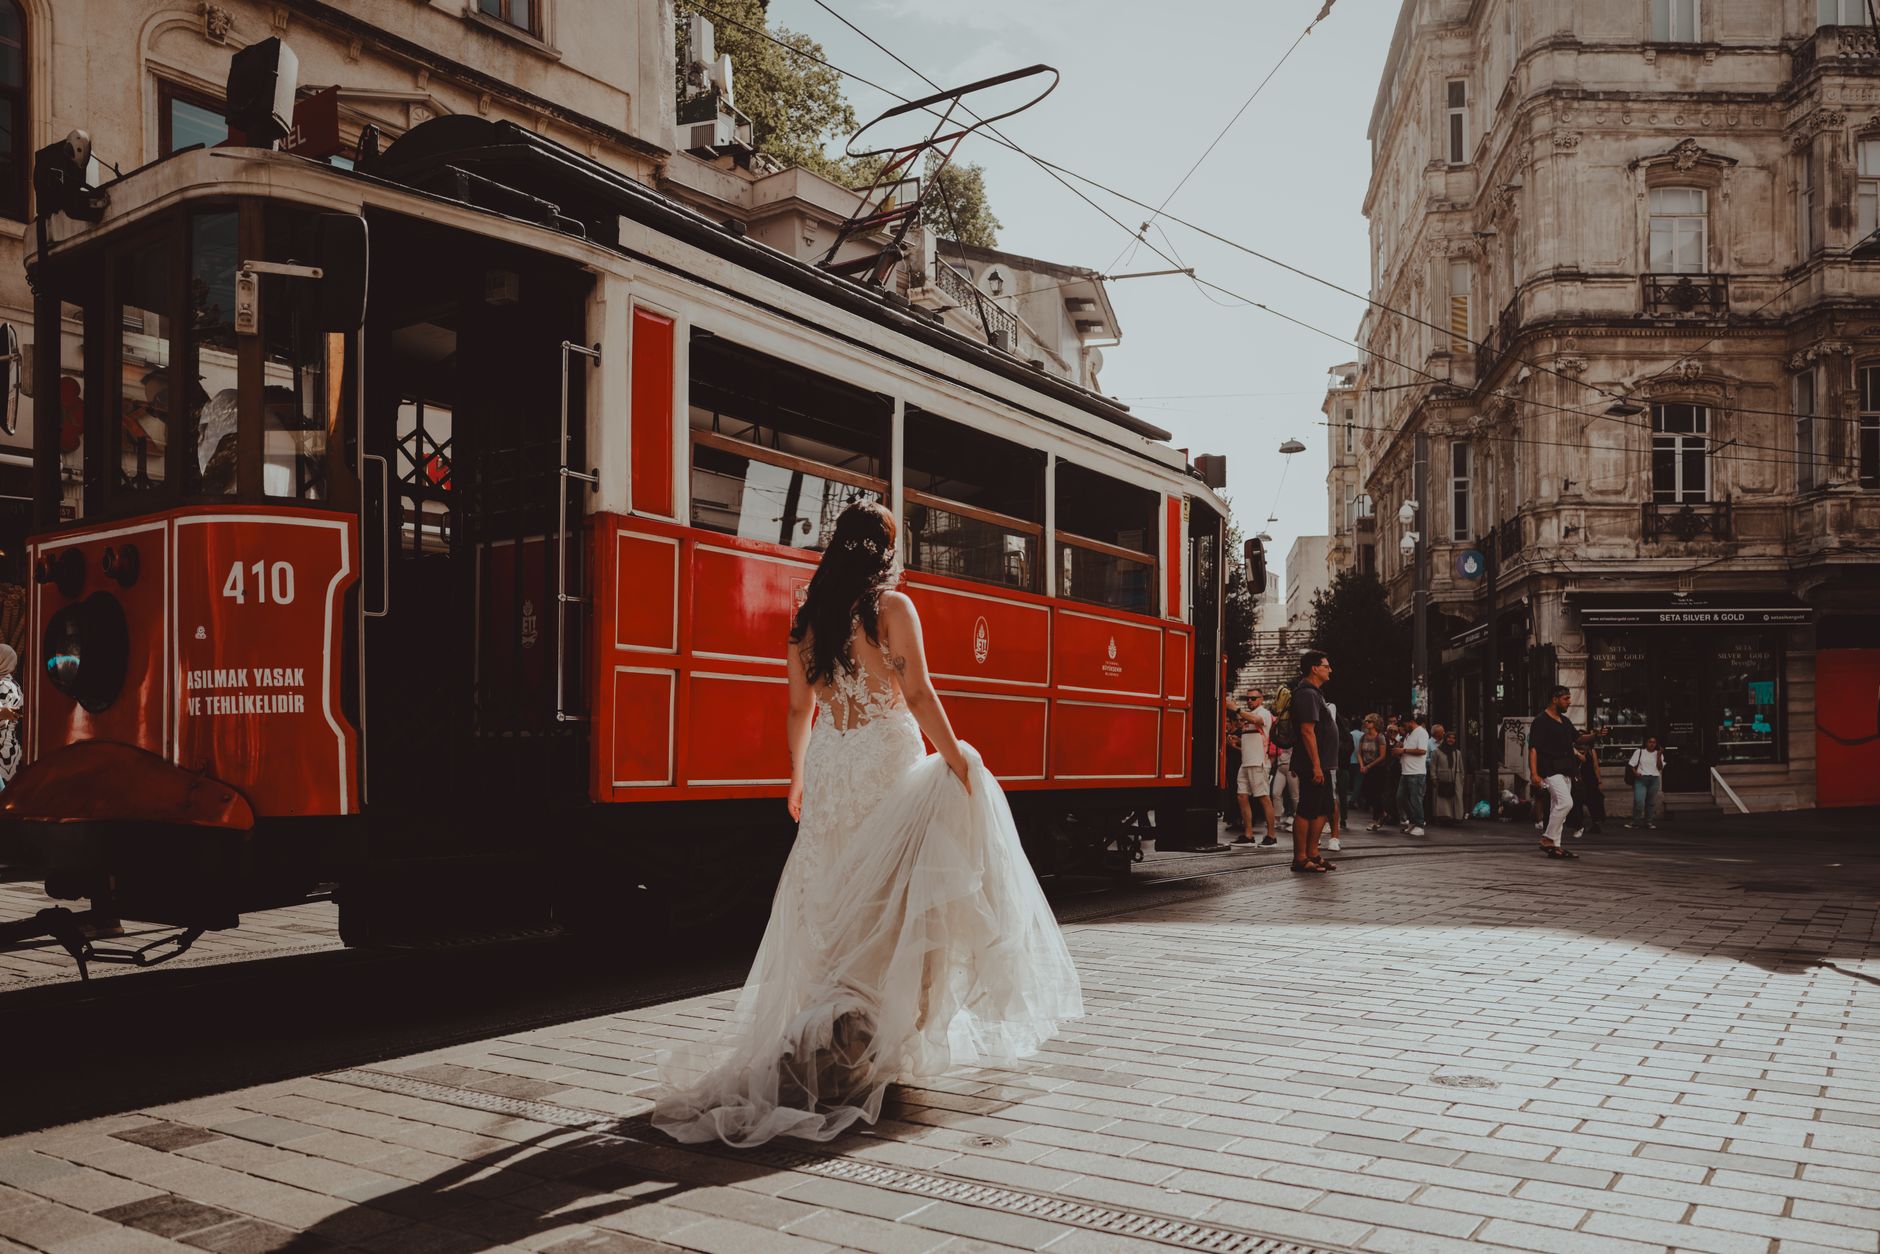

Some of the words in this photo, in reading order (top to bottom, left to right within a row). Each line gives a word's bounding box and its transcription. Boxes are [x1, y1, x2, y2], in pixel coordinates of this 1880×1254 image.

[222, 559, 296, 605] 410
[1659, 613, 1681, 622] SETA
[1682, 613, 1712, 622] SILVER
[1712, 613, 1720, 622] &
[1720, 612, 1745, 622] GOLD
[187, 669, 249, 690] ASILMAK
[253, 668, 305, 687] YASAK
[189, 697, 201, 716] VE
